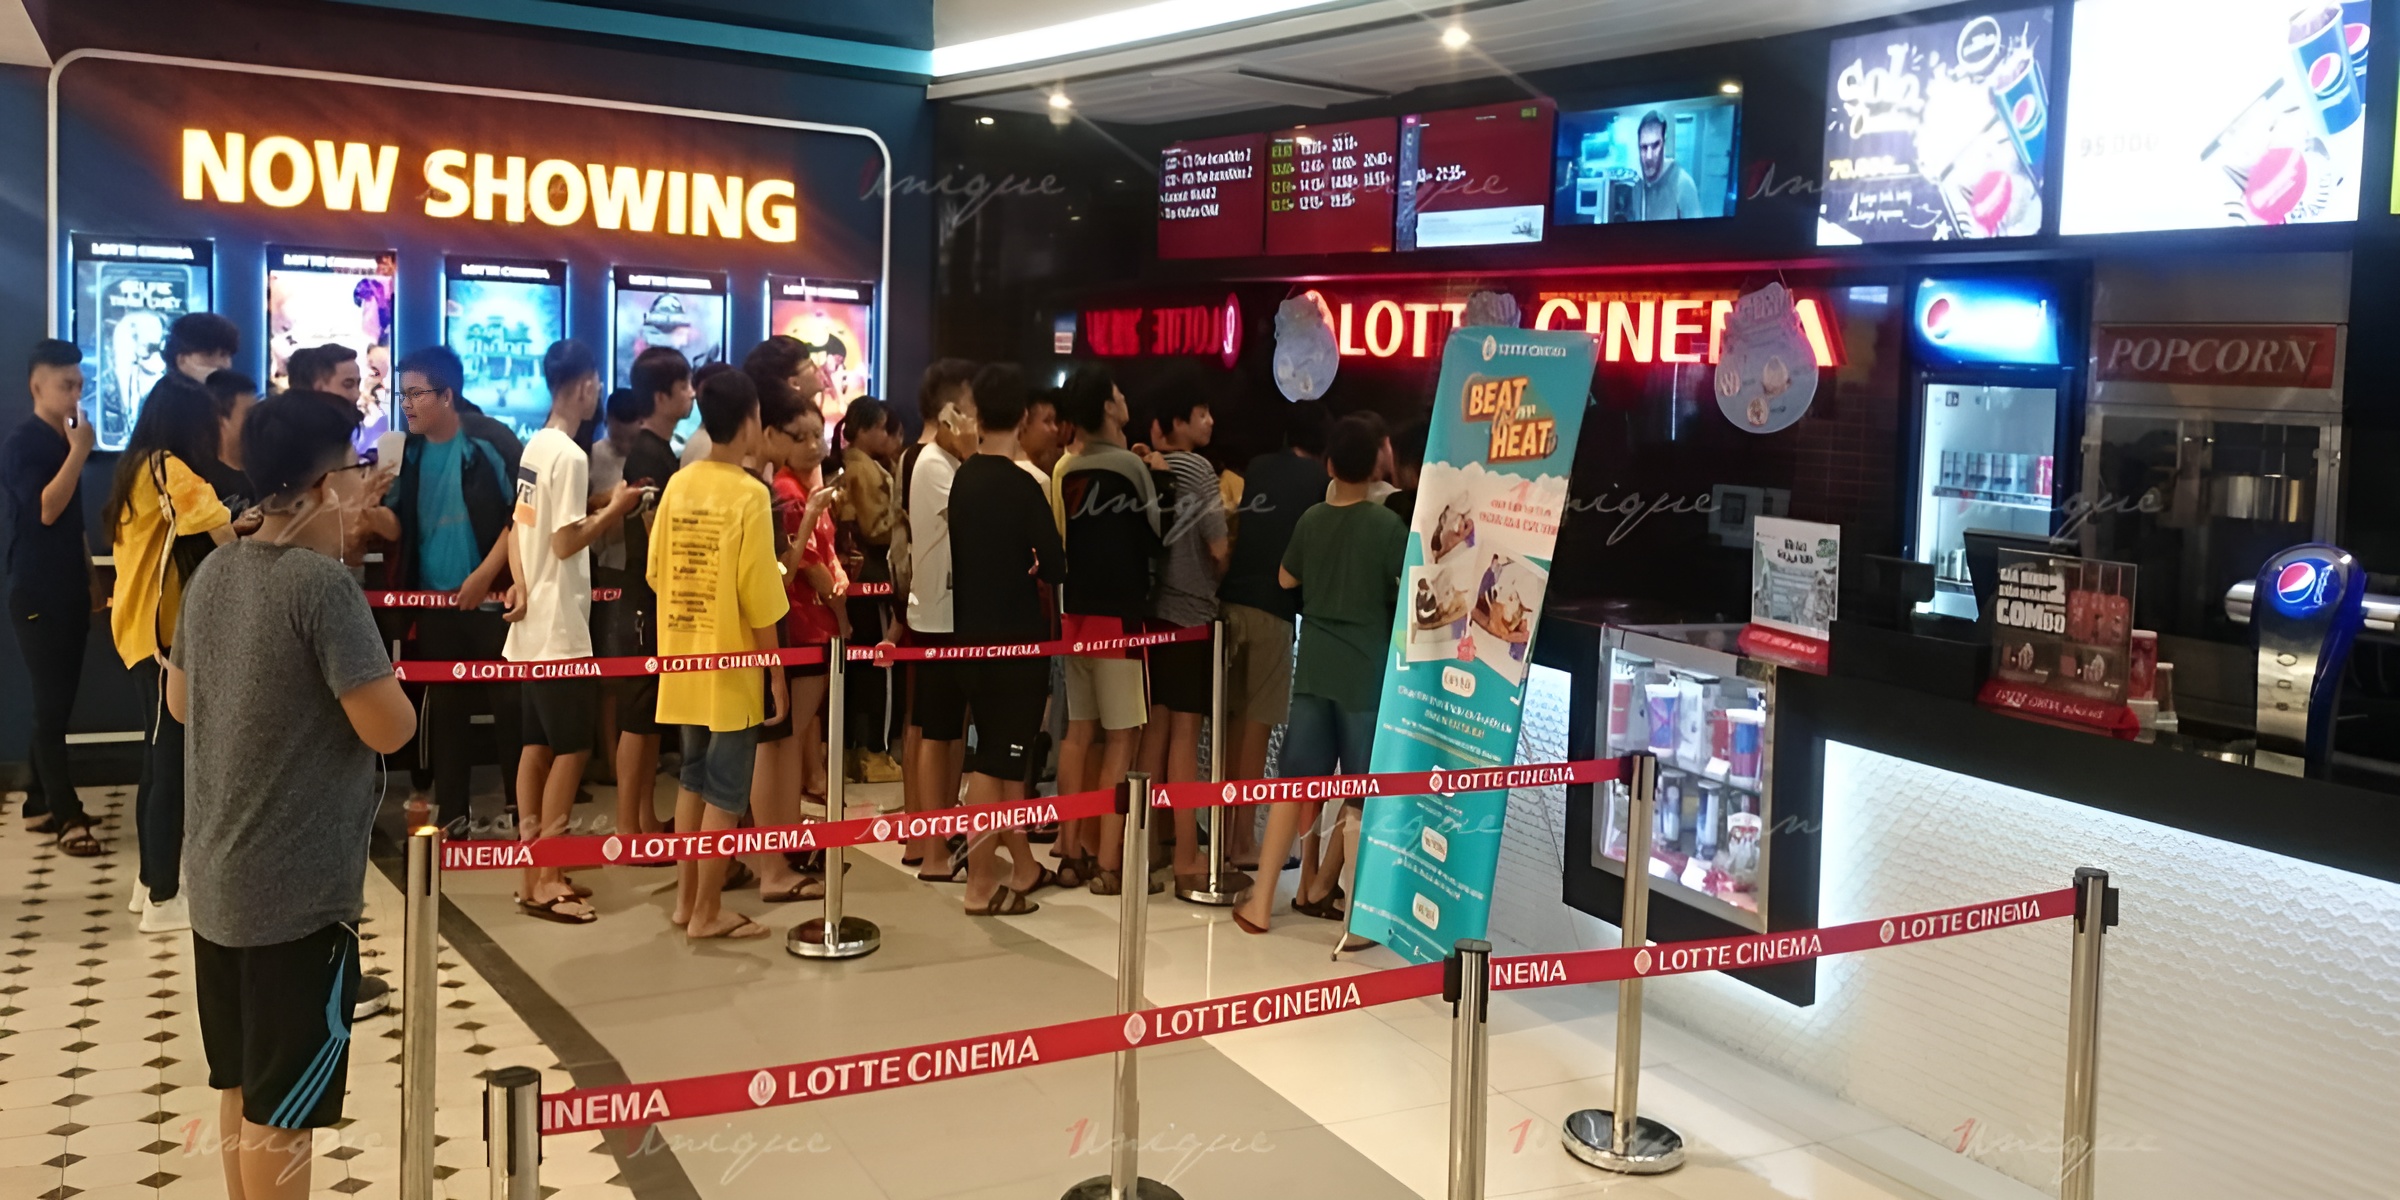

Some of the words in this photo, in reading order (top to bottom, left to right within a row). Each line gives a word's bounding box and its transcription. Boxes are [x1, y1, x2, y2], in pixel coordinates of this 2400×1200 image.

[181, 127, 400, 213] NOW
[421, 148, 799, 244] SHOWING
[1340, 299, 1468, 358] LOTT
[2107, 337, 2318, 374] POPCORN
[1469, 378, 1529, 416] BEAT
[1490, 421, 1554, 460] HEAT
[1996, 598, 2067, 634] COMBO
[1242, 781, 1303, 801] LOTTE
[1307, 778, 1380, 799] CINEMA
[1447, 771, 1503, 791] LOTTE
[1507, 765, 1575, 787] CINEMA
[898, 812, 970, 839] LOTTE
[973, 804, 1059, 832] CINEMA
[445, 845, 534, 867] INEMA
[629, 834, 713, 859] LOTTE
[716, 828, 817, 857] CINEMA
[1899, 911, 1963, 940] LOTTE
[1966, 900, 2042, 933] CINEMA
[1659, 944, 1732, 972] LOTTE
[1735, 934, 1823, 965] CINEMA
[1490, 960, 1567, 986] NEMA
[1155, 1000, 1248, 1039] LOTTE
[1252, 982, 1362, 1024] CINEMA
[787, 1056, 901, 1101] LOTTE
[906, 1035, 1040, 1083] CINEMA
[542, 1088, 671, 1131] INEMA
